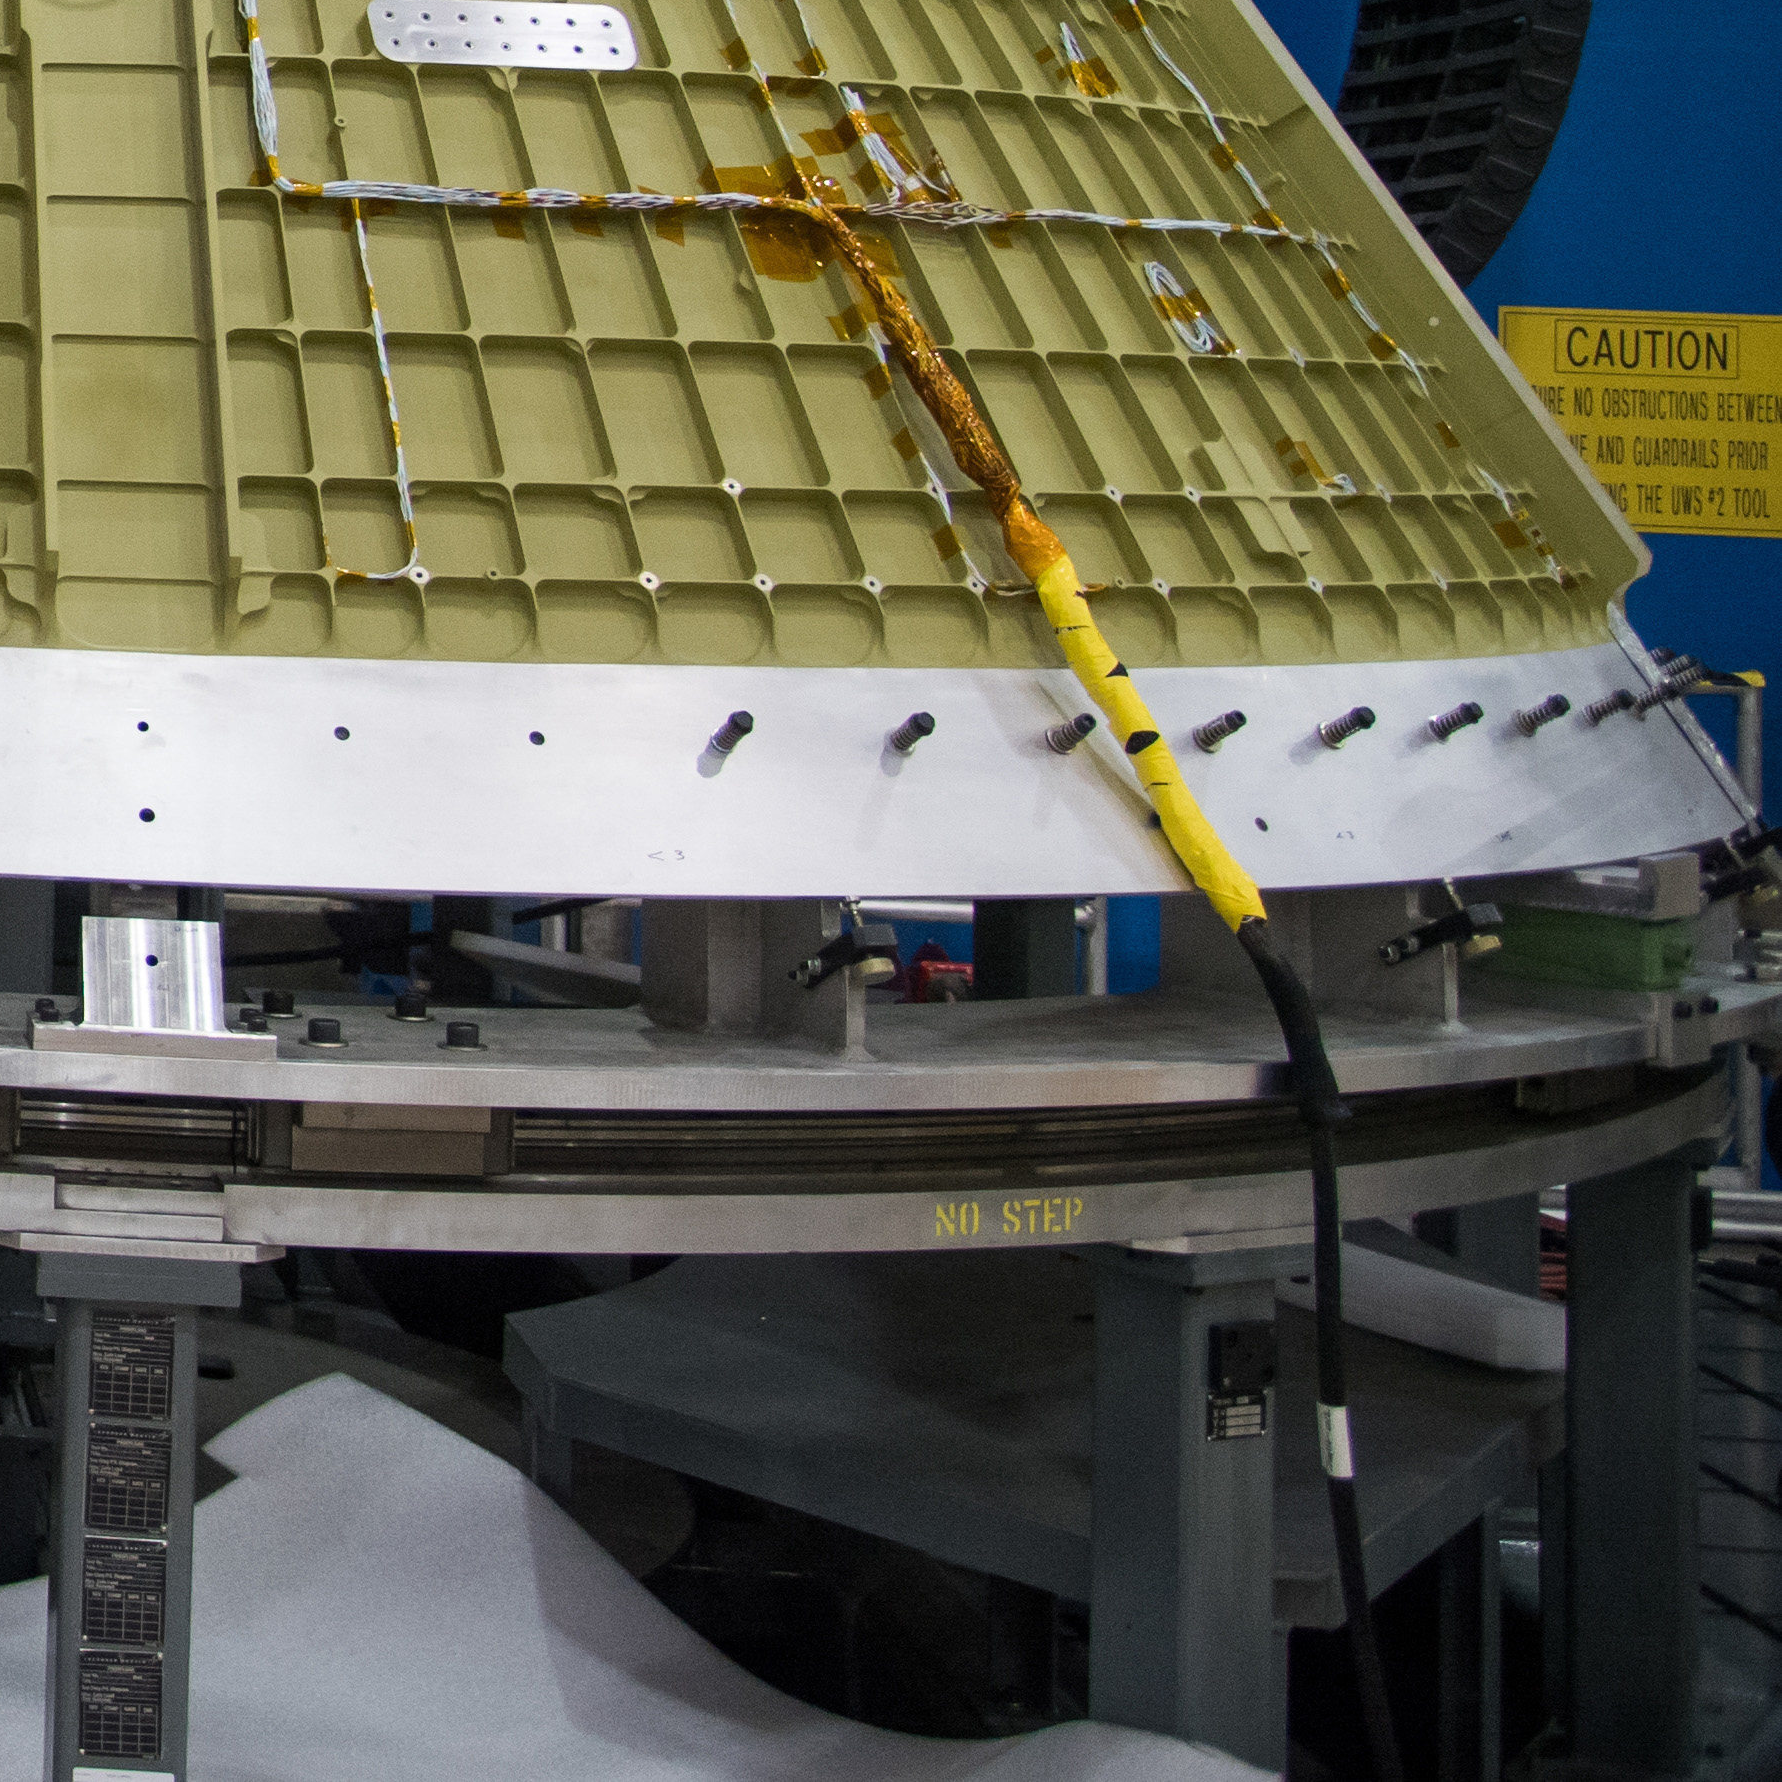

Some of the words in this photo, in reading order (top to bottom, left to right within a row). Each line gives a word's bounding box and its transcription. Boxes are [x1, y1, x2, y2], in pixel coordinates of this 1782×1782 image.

[1567, 326, 1728, 371] CAUTION
[1573, 386, 1593, 417] NO
[1601, 388, 1708, 421] OBSTRUCTIONS
[1716, 392, 1782, 424] BETWEEN
[1596, 435, 1626, 466] AND
[1633, 435, 1720, 469] GUARDRAILS
[1727, 440, 1769, 471] PRIOR
[1637, 485, 1664, 516] THE
[1670, 486, 1704, 517] UWS
[1732, 487, 1771, 520] TOOL
[935, 1200, 980, 1237] NO
[1002, 1196, 1084, 1235] STEP
